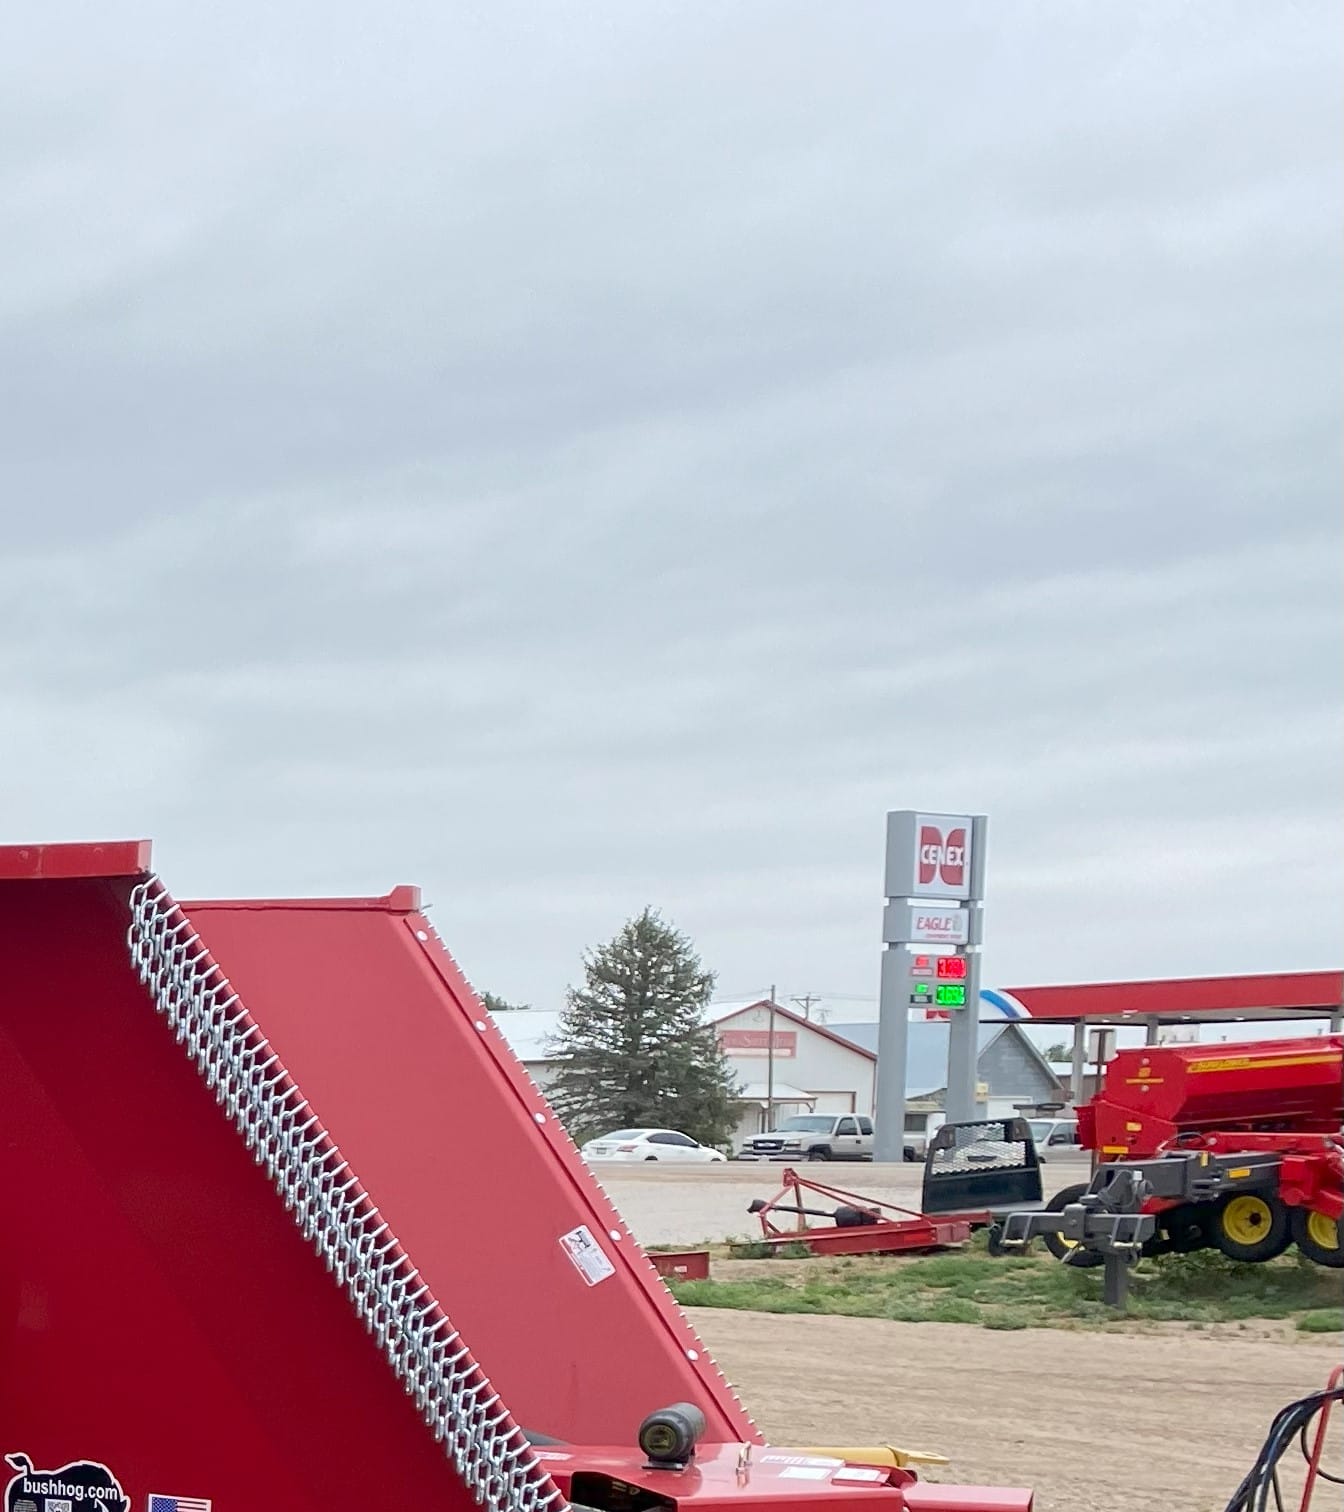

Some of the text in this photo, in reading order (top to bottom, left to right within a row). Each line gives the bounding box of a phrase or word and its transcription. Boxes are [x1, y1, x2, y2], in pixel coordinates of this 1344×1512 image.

[921, 844, 964, 866] CENEX
[916, 916, 952, 931] EAGLE
[23, 1477, 118, 1501] bushhog.com
